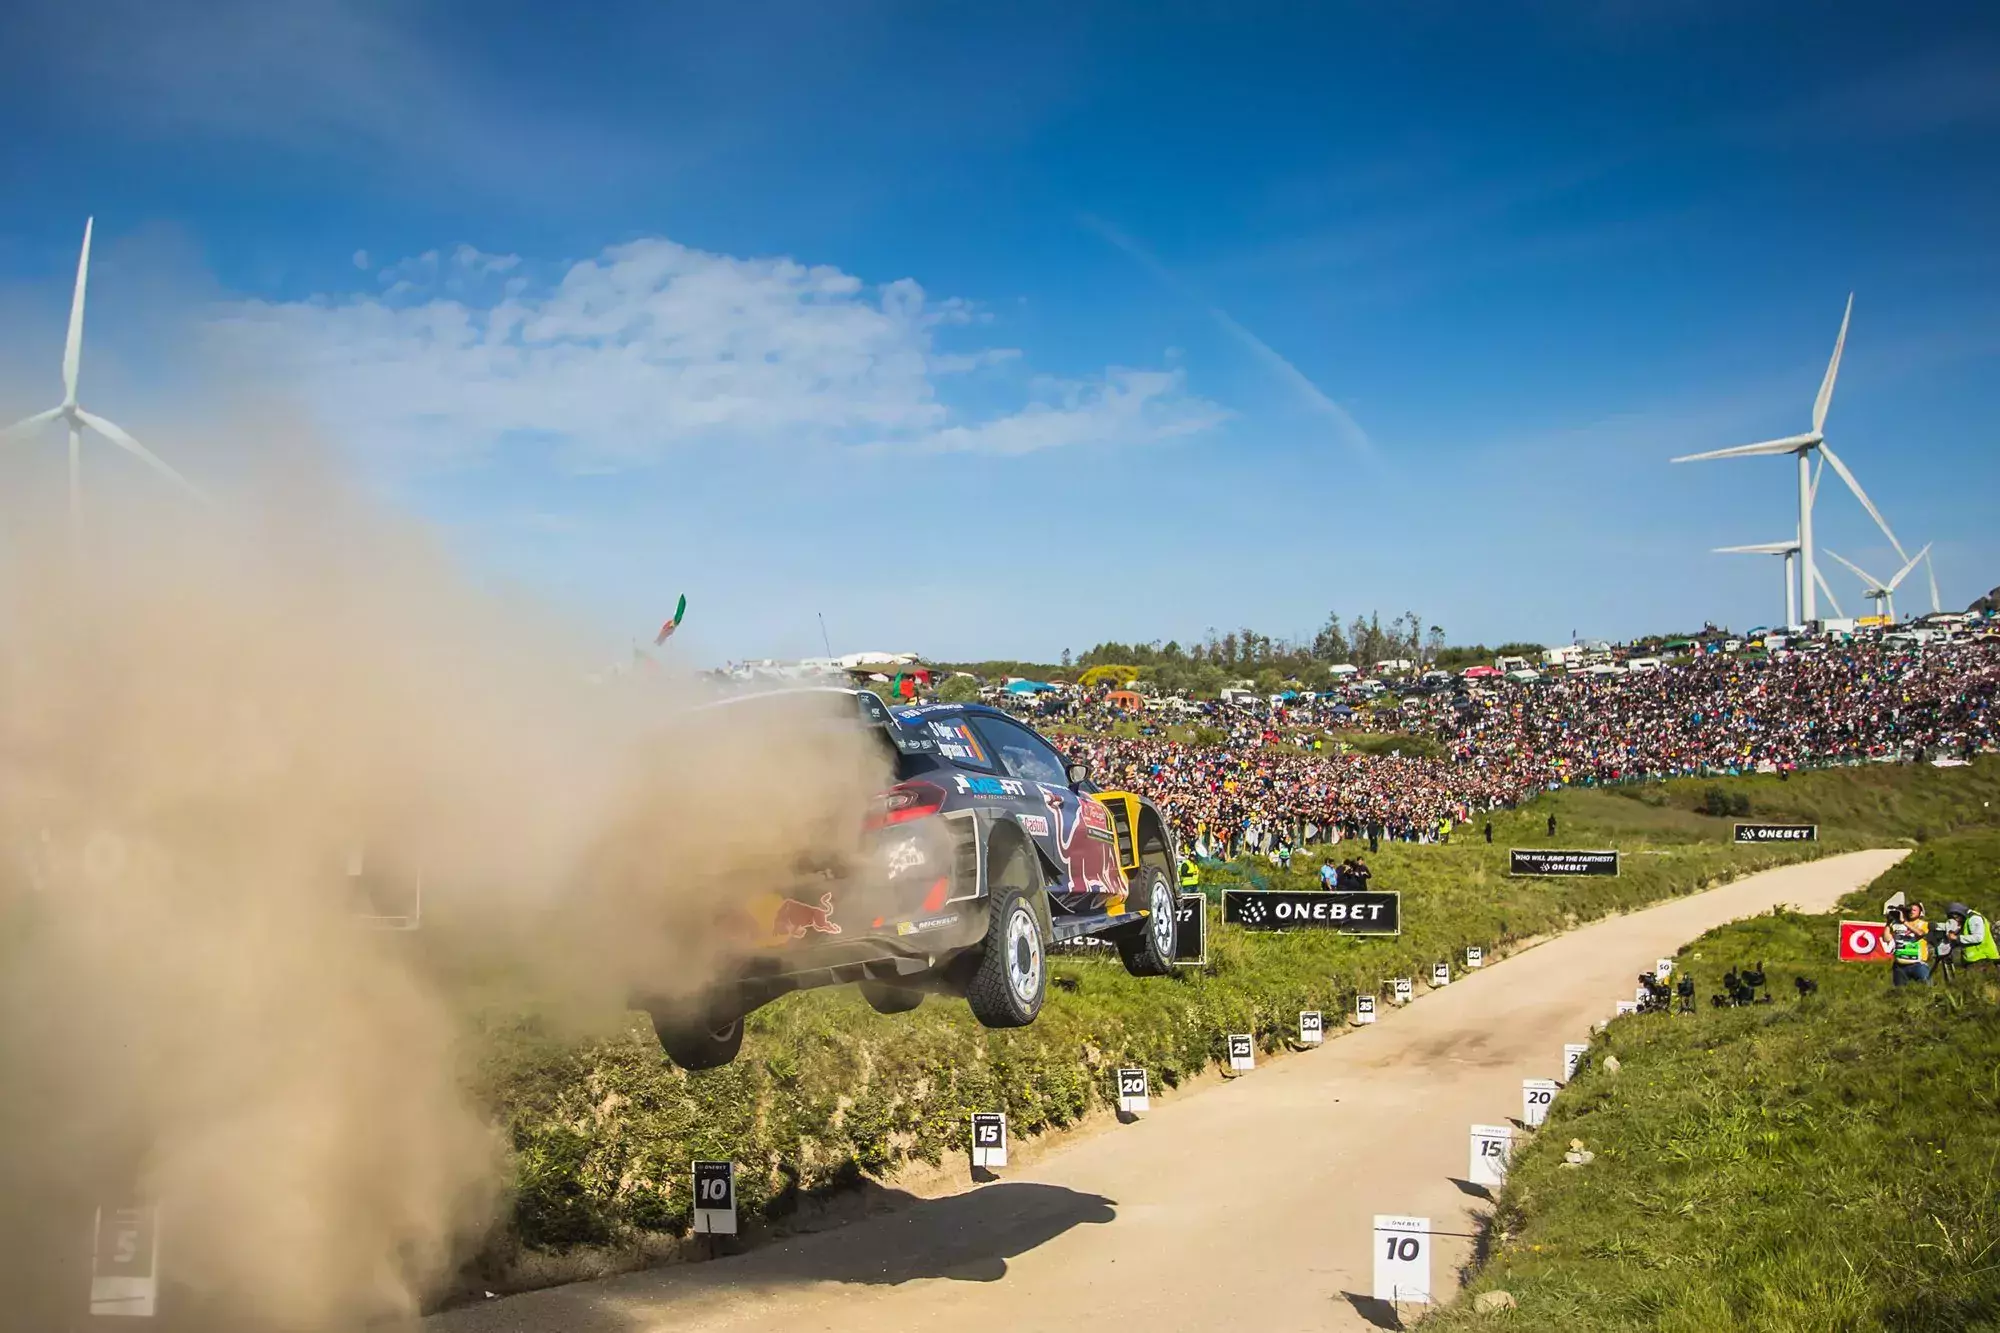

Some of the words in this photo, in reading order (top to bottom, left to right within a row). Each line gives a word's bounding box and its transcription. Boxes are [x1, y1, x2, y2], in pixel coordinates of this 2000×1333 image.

[1023, 817, 1048, 834] Castrol
[1757, 829, 1809, 839] ONEBET
[1275, 902, 1384, 920] ONEBET
[918, 915, 959, 929] MICHELIN
[1302, 1017, 1319, 1029] 30
[1233, 1042, 1250, 1055] 25
[1122, 1078, 1144, 1093] 20
[1527, 1091, 1551, 1105] 20
[979, 1125, 999, 1142] 15
[1481, 1140, 1502, 1157] 15
[701, 1178, 727, 1200] 10
[113, 1229, 138, 1263] 5
[1386, 1237, 1420, 1262] 10
